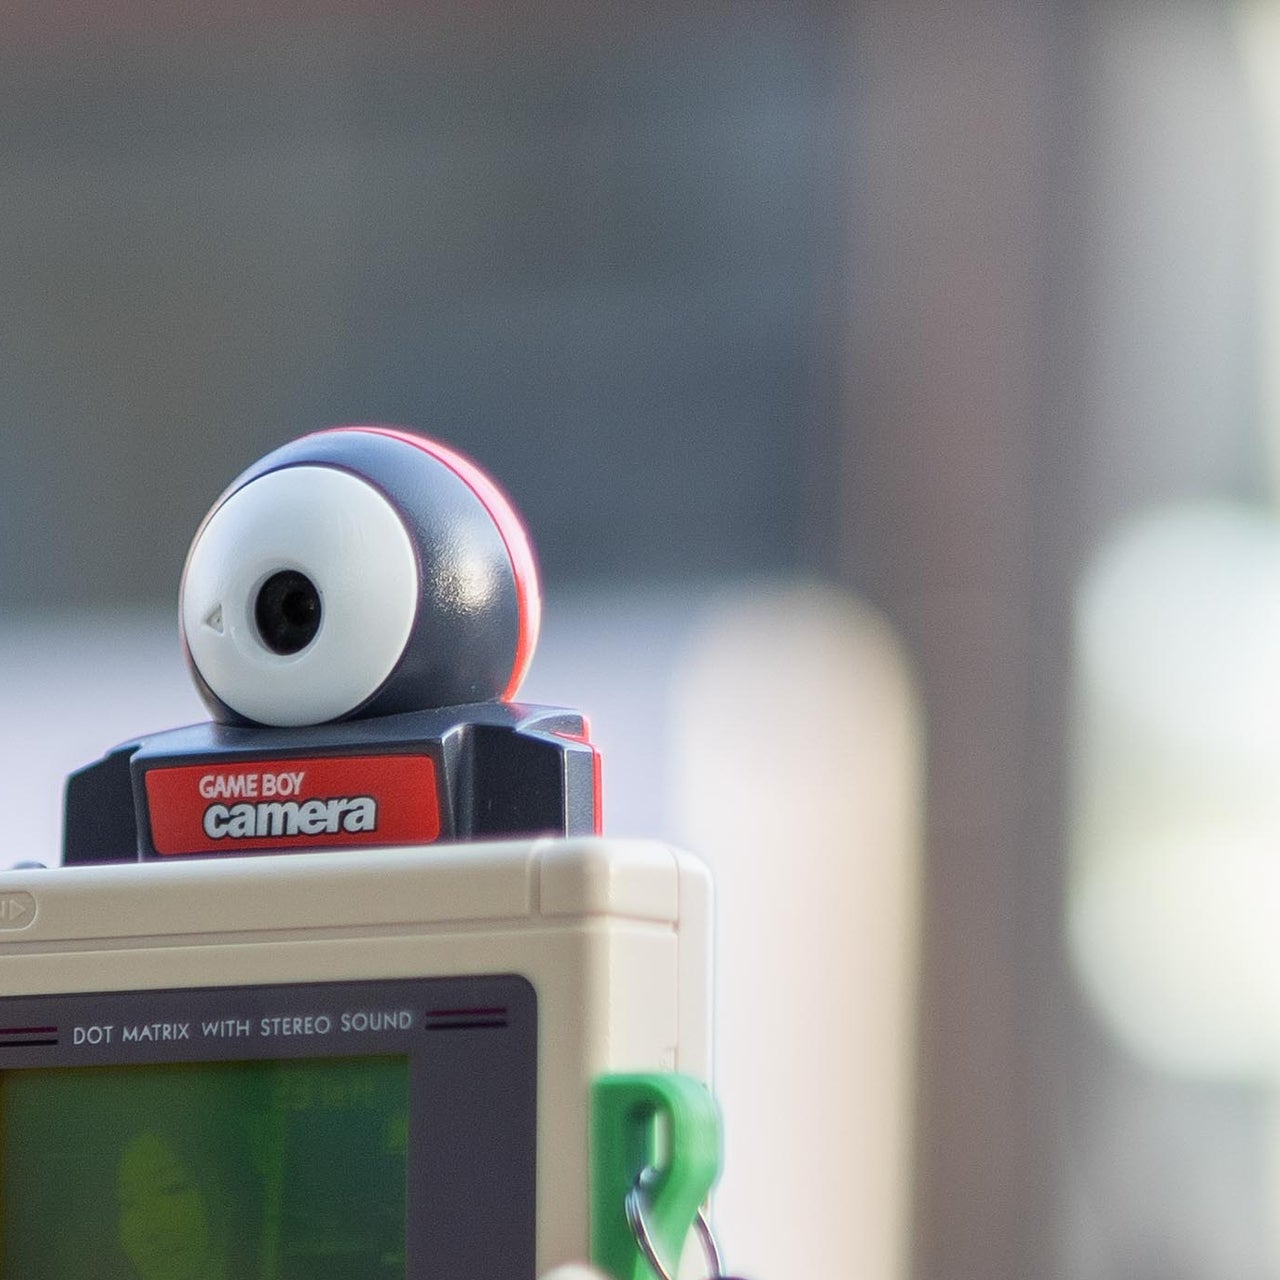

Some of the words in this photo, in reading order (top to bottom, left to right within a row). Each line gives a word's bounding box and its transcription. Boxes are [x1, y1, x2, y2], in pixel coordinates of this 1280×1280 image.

[199, 774, 258, 798] GAME
[262, 772, 305, 796] BOY
[203, 797, 377, 839] camera
[74, 1025, 113, 1045] DOT
[122, 1023, 190, 1042] MATRIX
[201, 1019, 250, 1038] WITH
[260, 1015, 331, 1037] STEREO
[341, 1011, 412, 1032] SOUND
